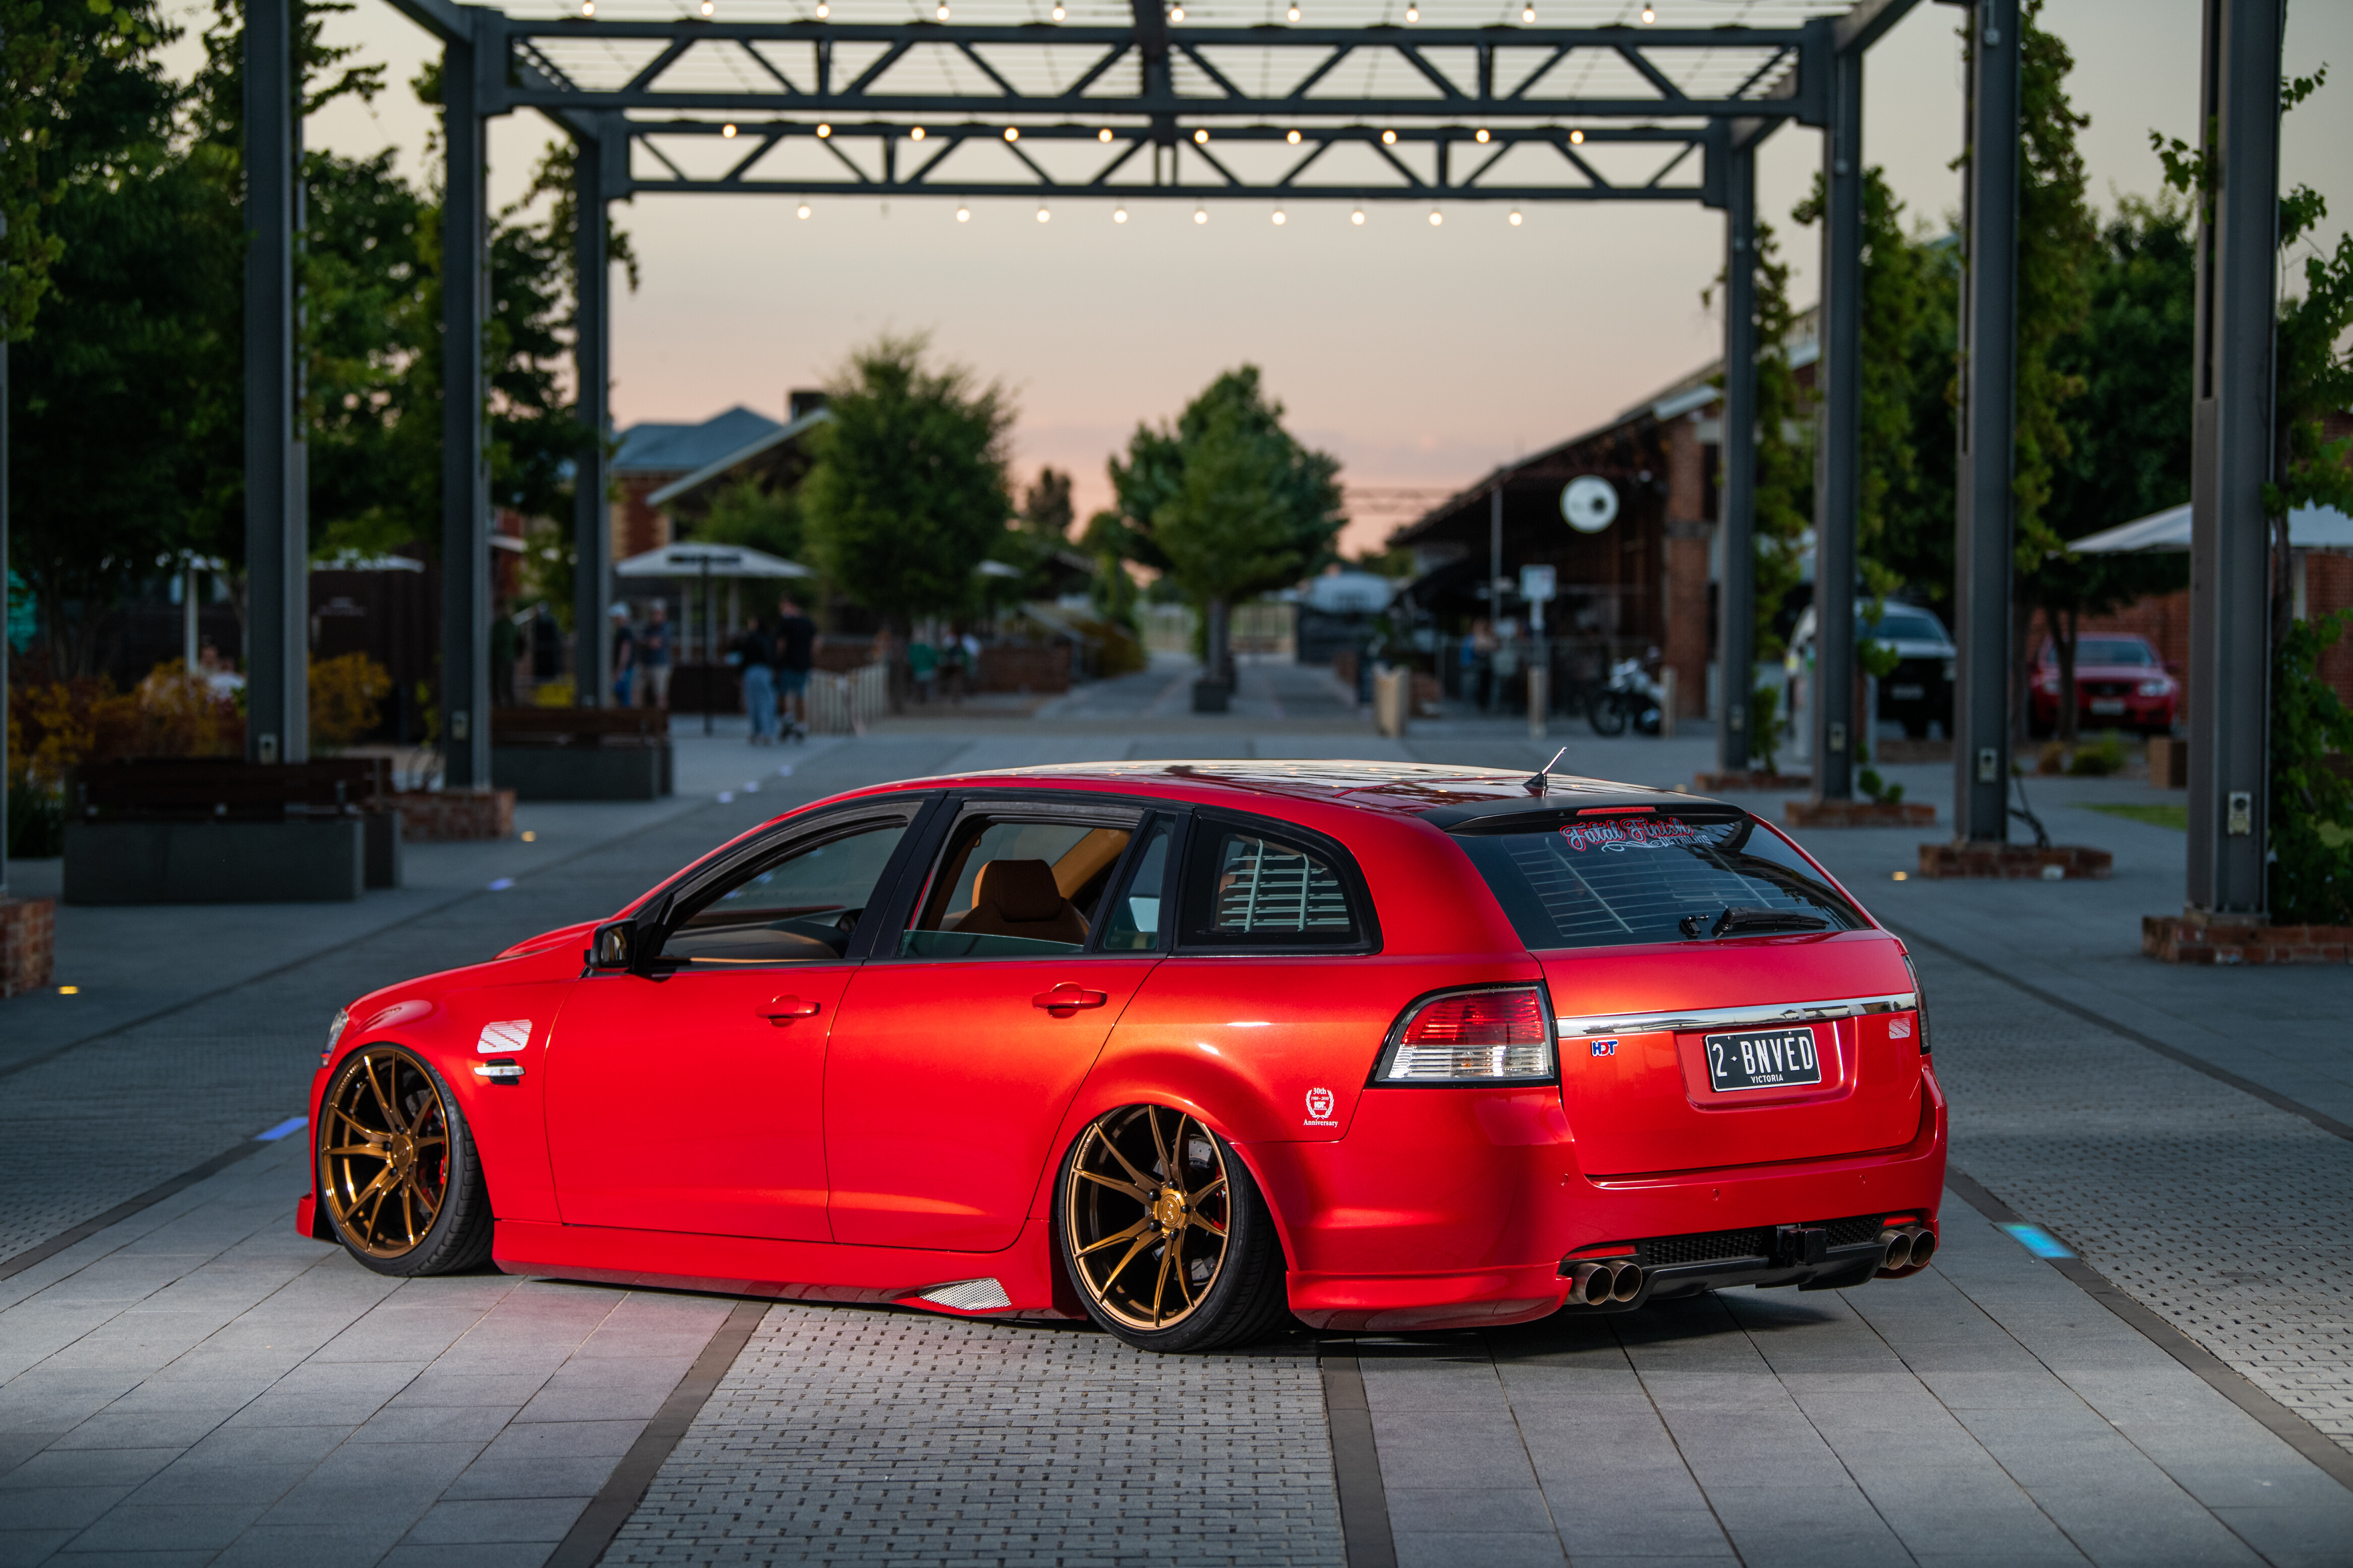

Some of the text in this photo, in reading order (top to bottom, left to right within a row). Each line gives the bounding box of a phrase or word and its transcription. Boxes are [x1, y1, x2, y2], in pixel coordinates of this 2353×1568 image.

[1562, 818, 1692, 850] Fatal Finish
[1592, 1040, 1618, 1057] HDT
[1751, 1074, 1783, 1084] VICTORIA
[1303, 1119, 1338, 1128] Anniversary
